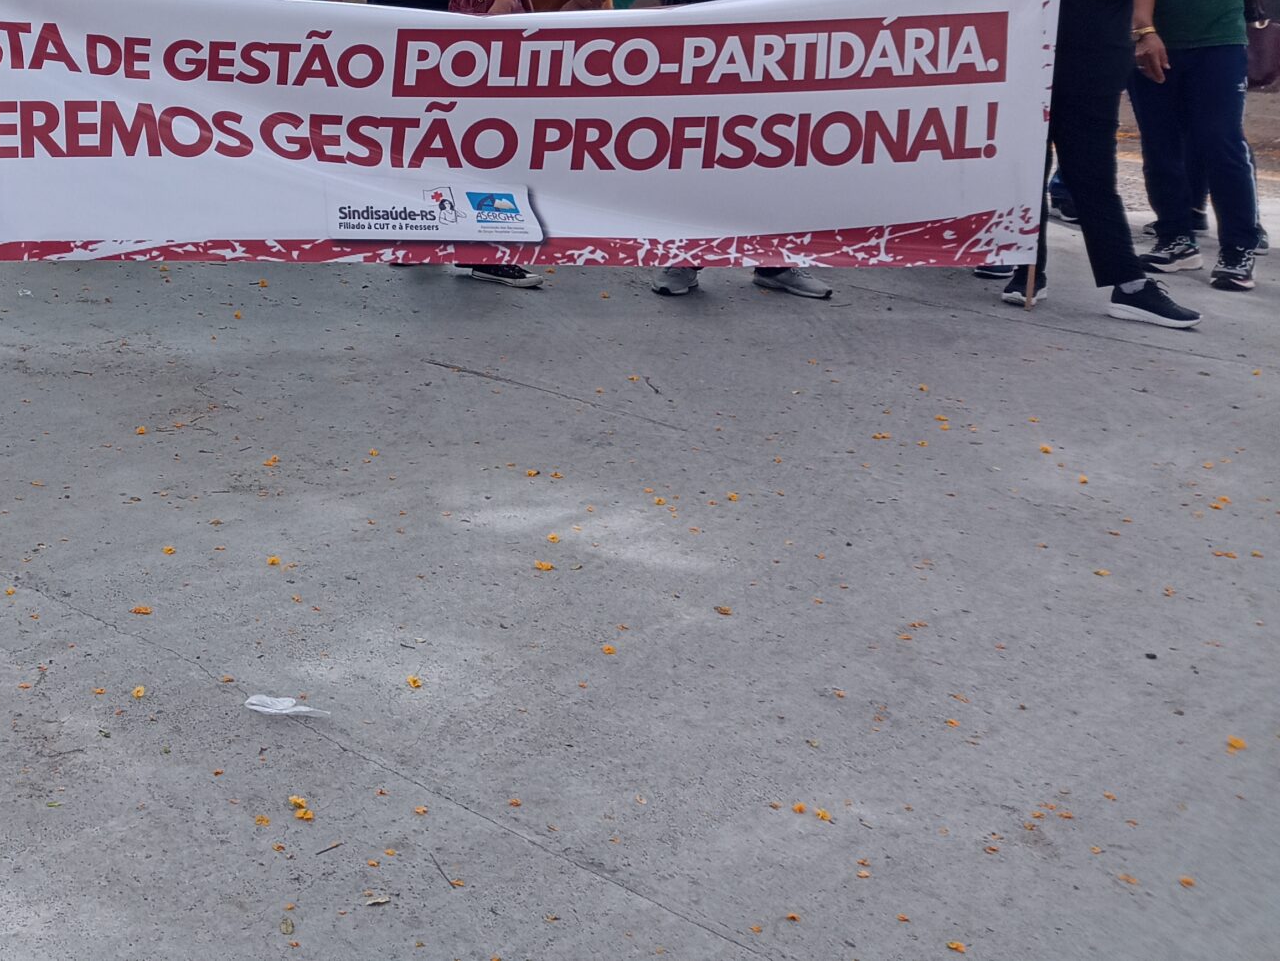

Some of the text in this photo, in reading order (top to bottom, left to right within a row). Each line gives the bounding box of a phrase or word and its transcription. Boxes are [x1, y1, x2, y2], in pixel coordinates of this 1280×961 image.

[86, 34, 151, 80] DE
[164, 30, 385, 88] GESTÃO
[403, 16, 1000, 87] POLÍTICO-PARTIDÁRIA.
[260, 100, 519, 170] GESTÃO
[530, 102, 999, 171] PROFISSIONAL!
[338, 205, 437, 221] Sindisaúde-RS
[374, 223, 391, 231] CUT
[405, 223, 440, 231] Feessers
